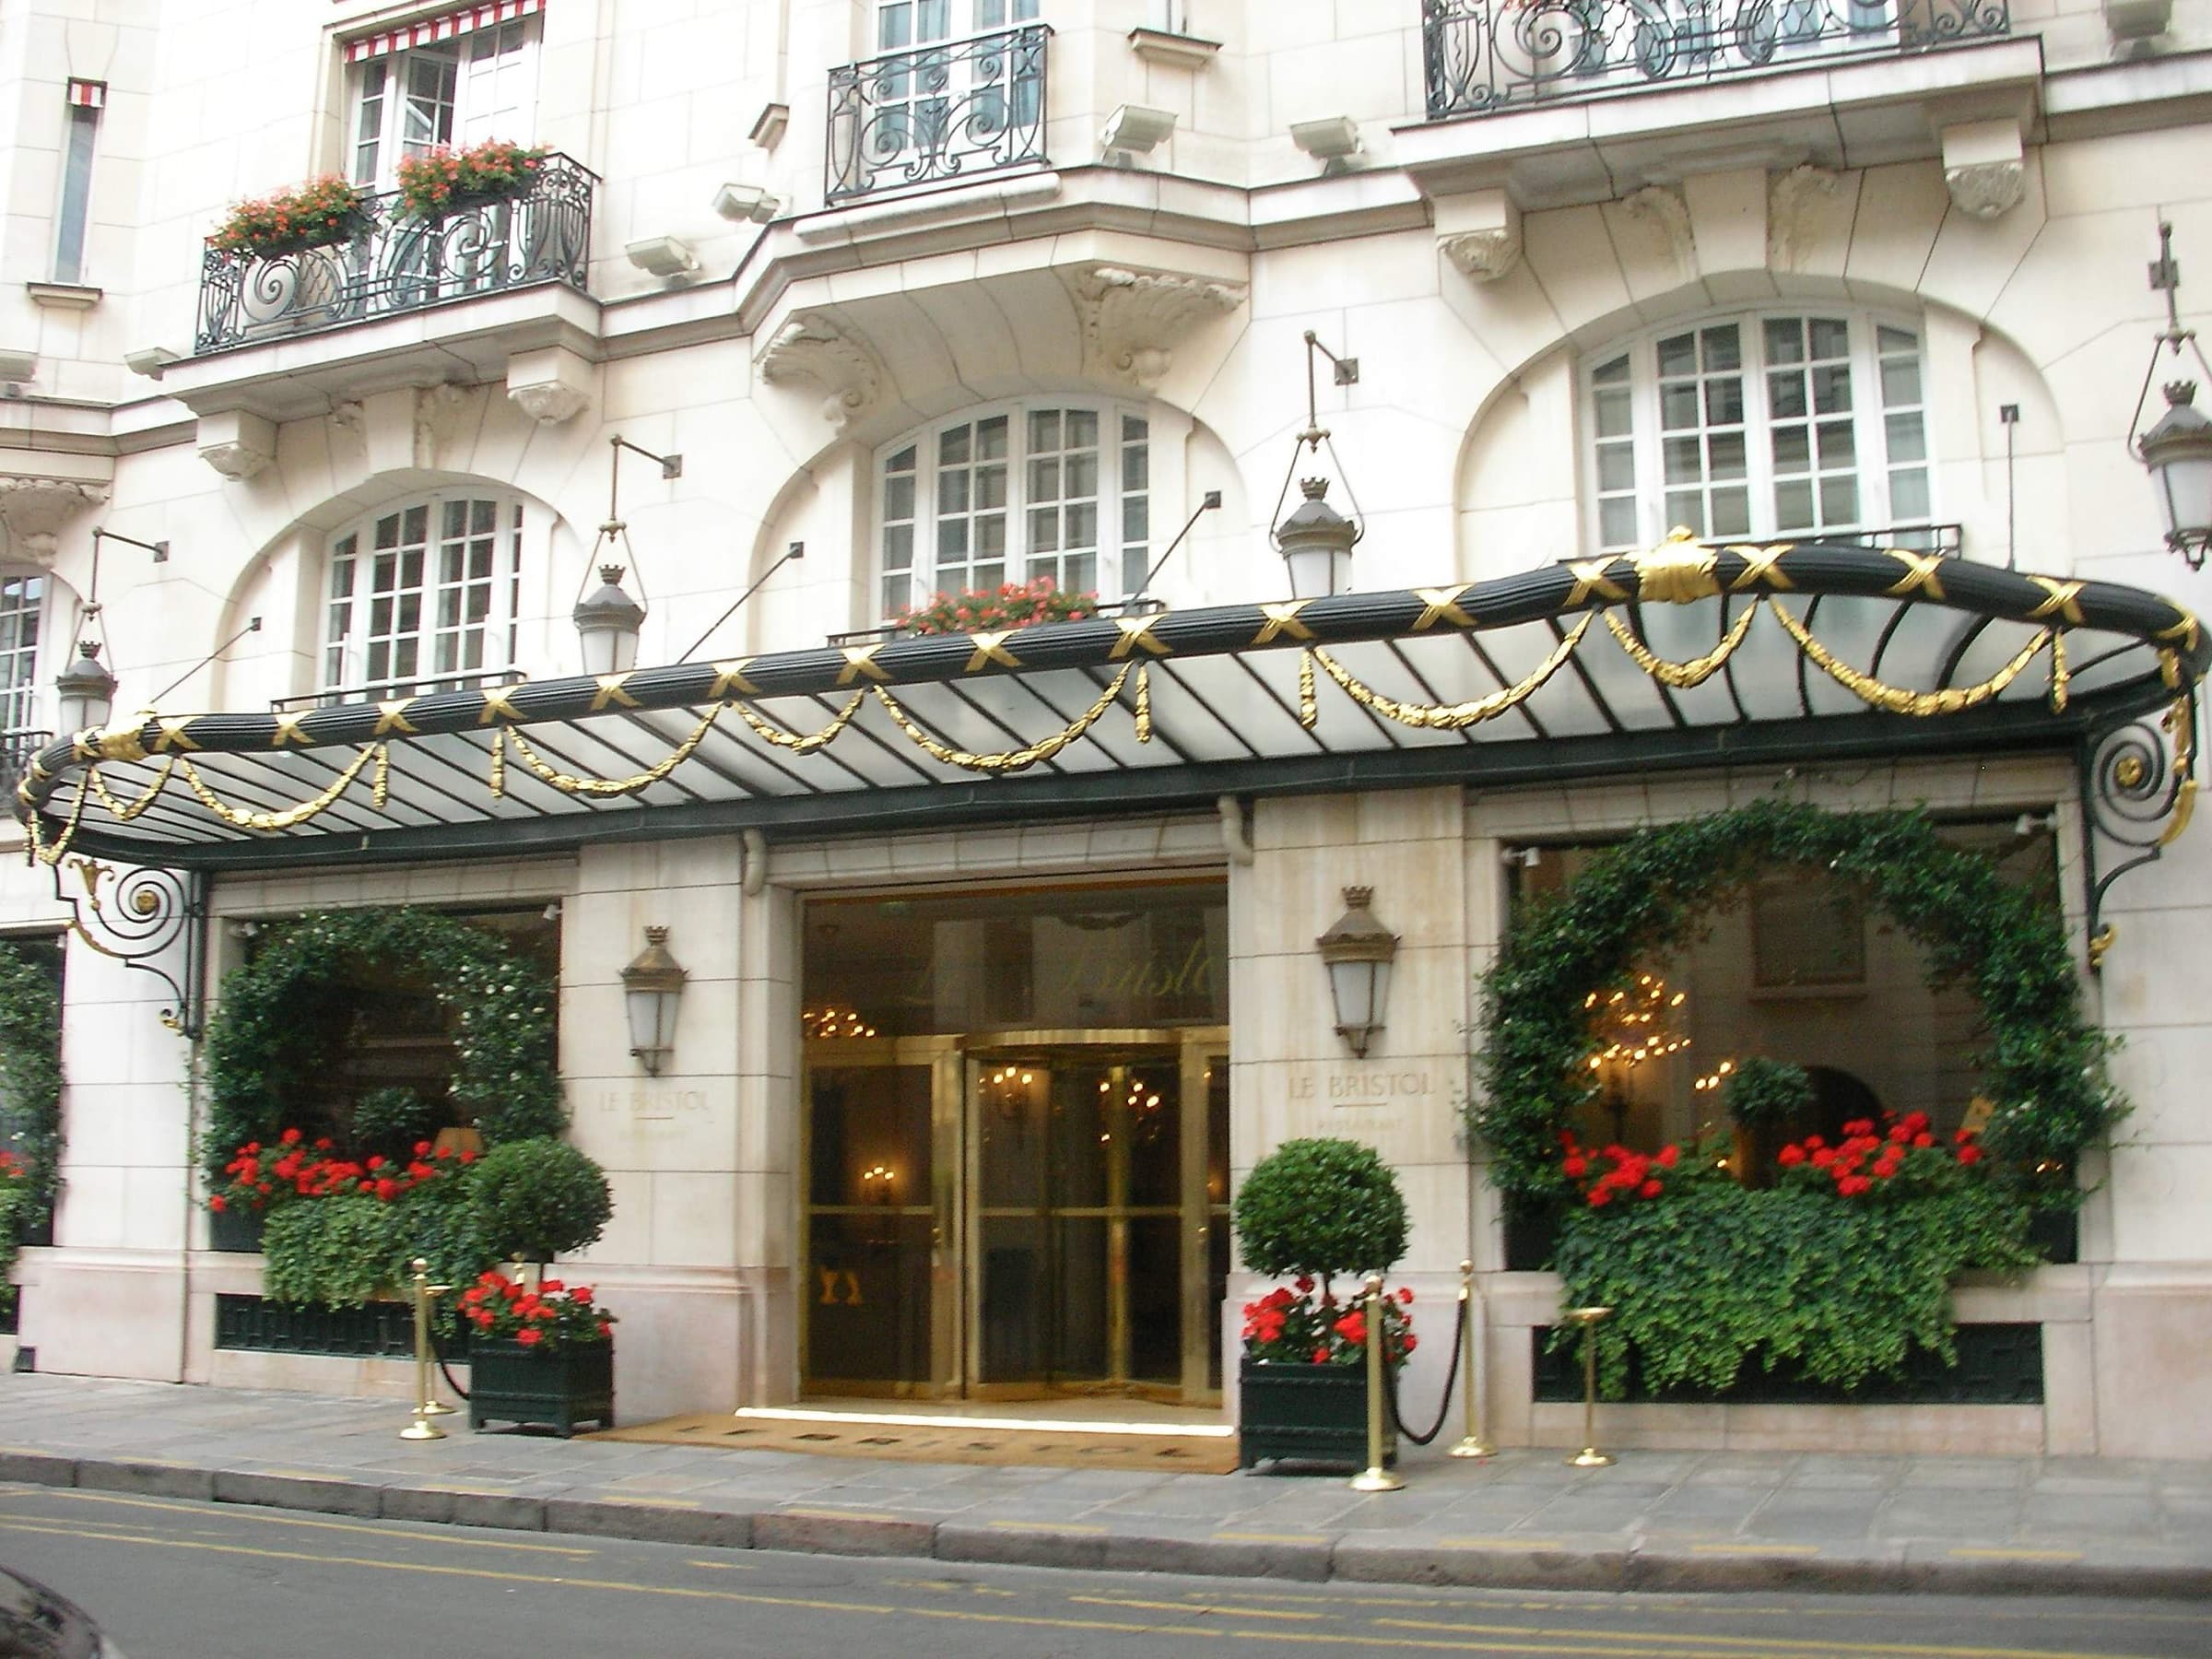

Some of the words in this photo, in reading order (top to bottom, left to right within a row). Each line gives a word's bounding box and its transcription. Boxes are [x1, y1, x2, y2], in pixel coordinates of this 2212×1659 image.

[1288, 1077, 1315, 1099] LE
[1329, 1073, 1435, 1098] BRISTOL
[600, 1091, 620, 1112] LE
[629, 1090, 710, 1111] BRISTOL
